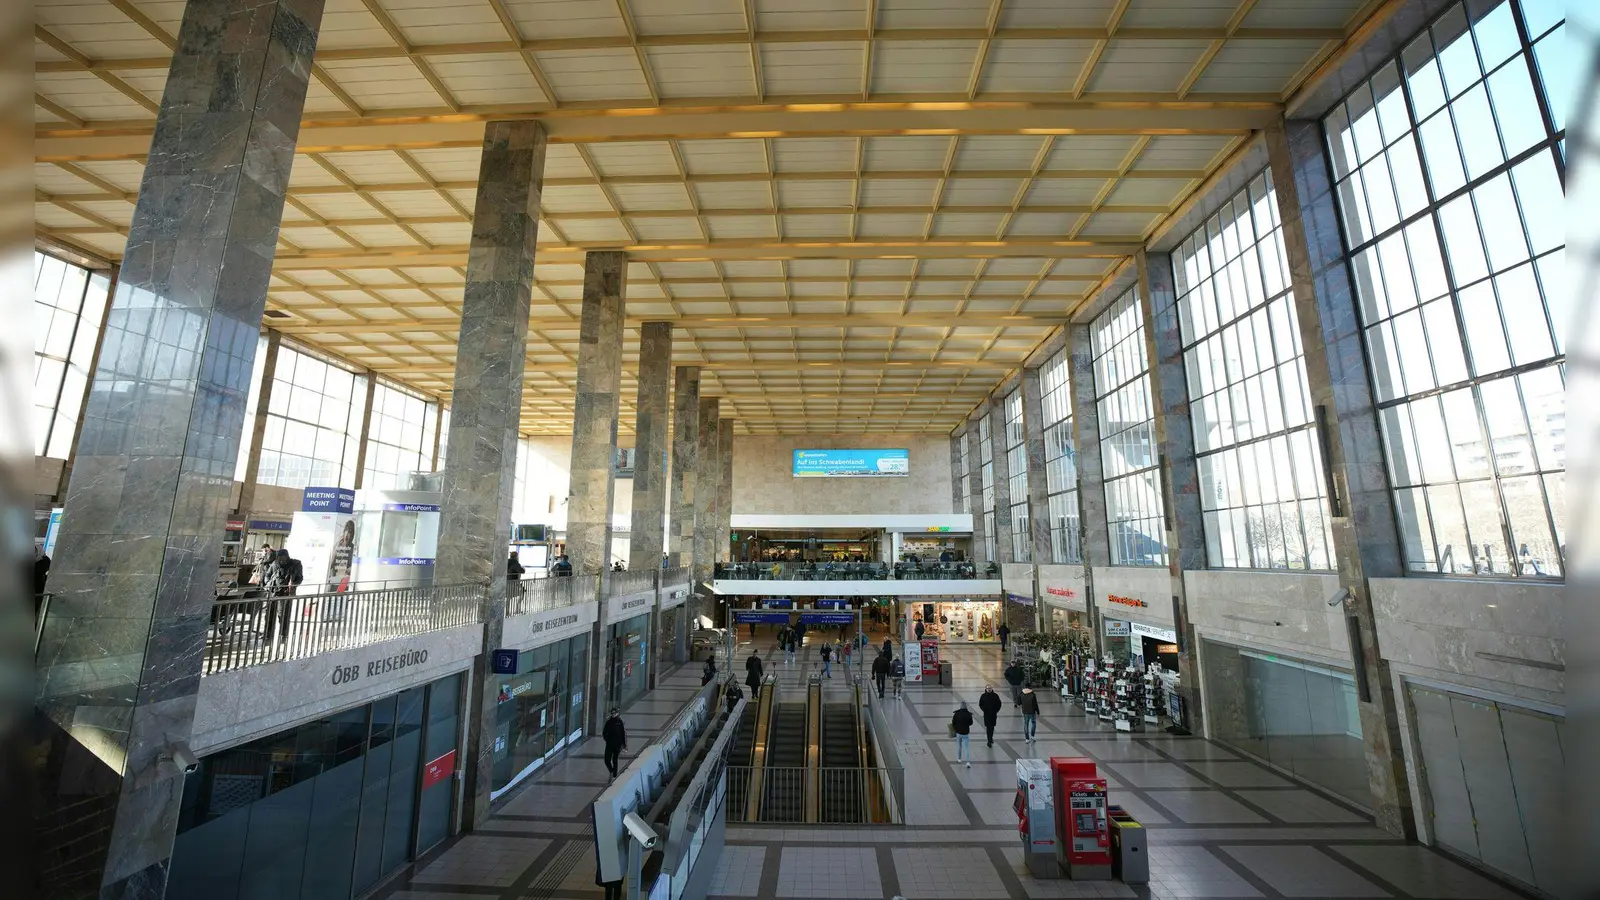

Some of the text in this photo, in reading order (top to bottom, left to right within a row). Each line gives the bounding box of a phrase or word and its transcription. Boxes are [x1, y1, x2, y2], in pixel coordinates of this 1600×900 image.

[532, 621, 543, 634] ÖBB
[331, 649, 428, 685] ÖBB REISEBÜRO
